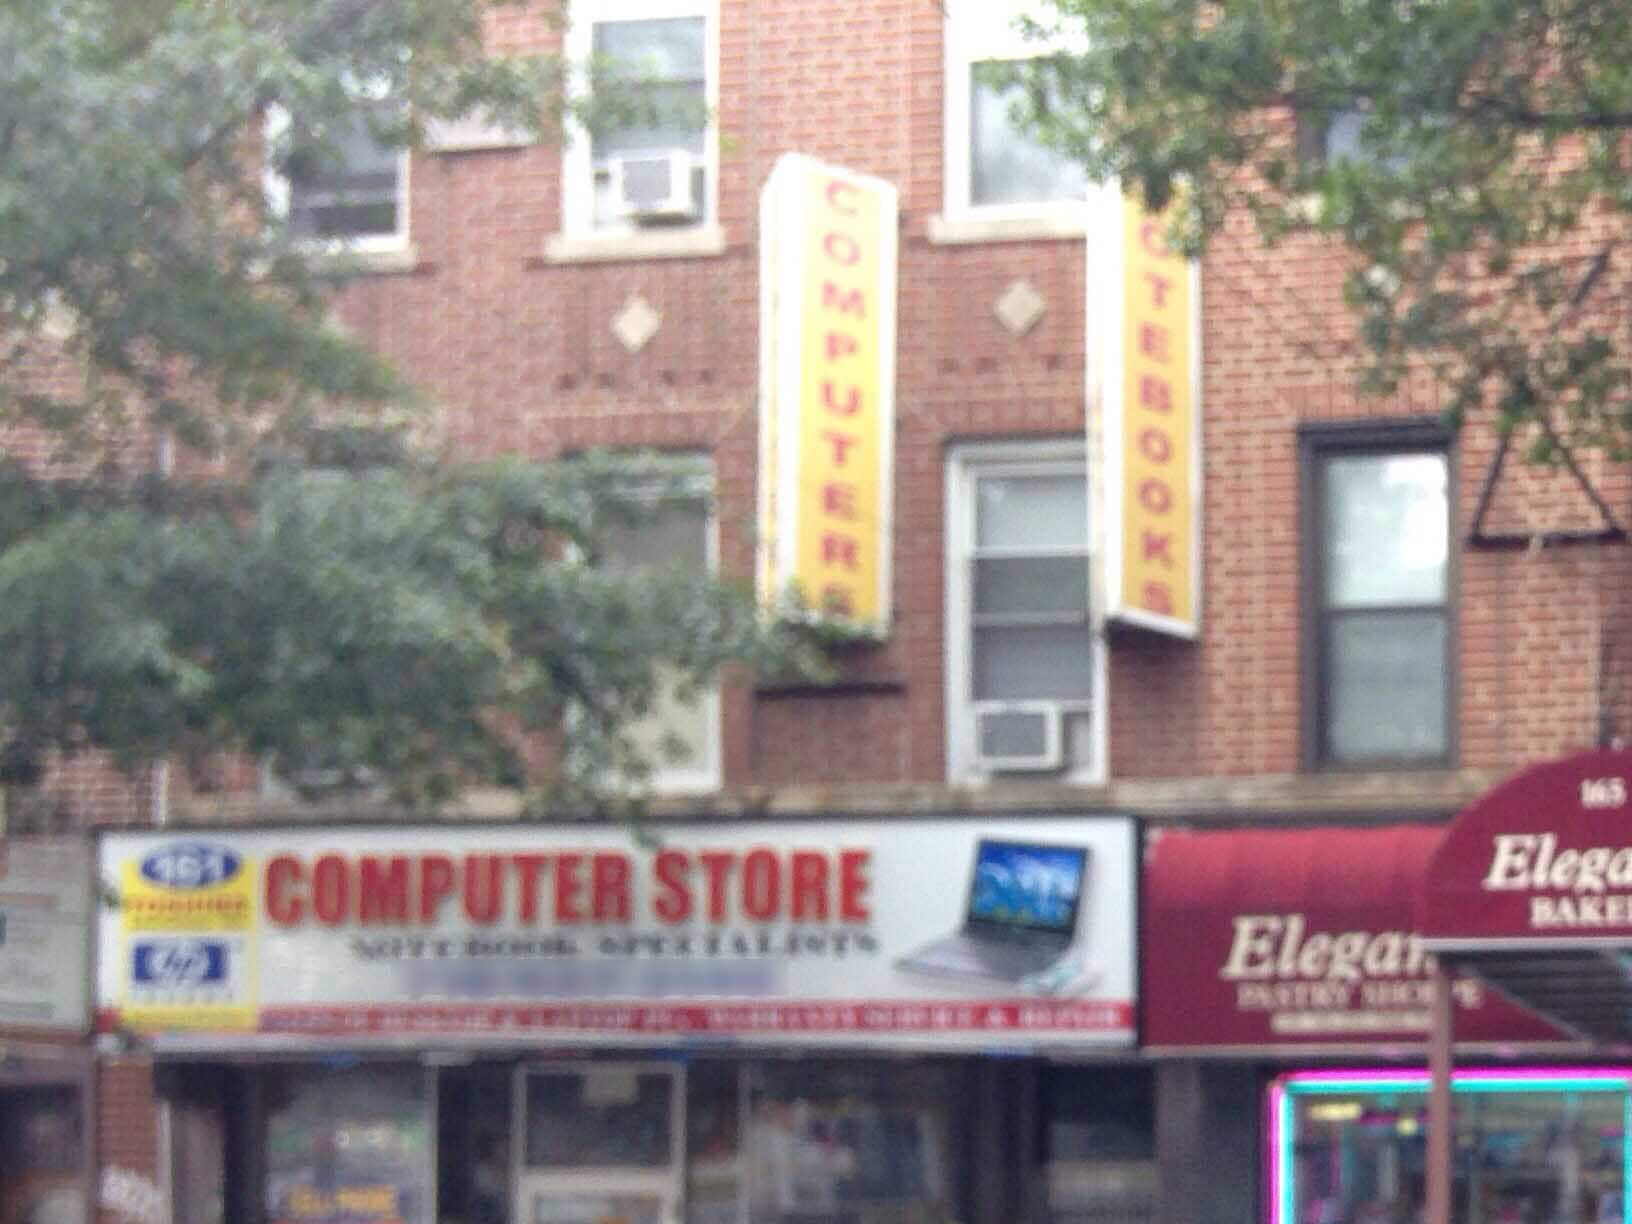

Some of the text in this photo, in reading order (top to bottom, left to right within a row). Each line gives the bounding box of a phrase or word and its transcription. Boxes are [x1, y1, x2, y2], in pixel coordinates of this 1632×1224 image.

[1136, 213, 1176, 619] OTEBOOKS
[263, 848, 872, 928] COMPUTER STORE
[1221, 913, 1440, 983] Elegan
